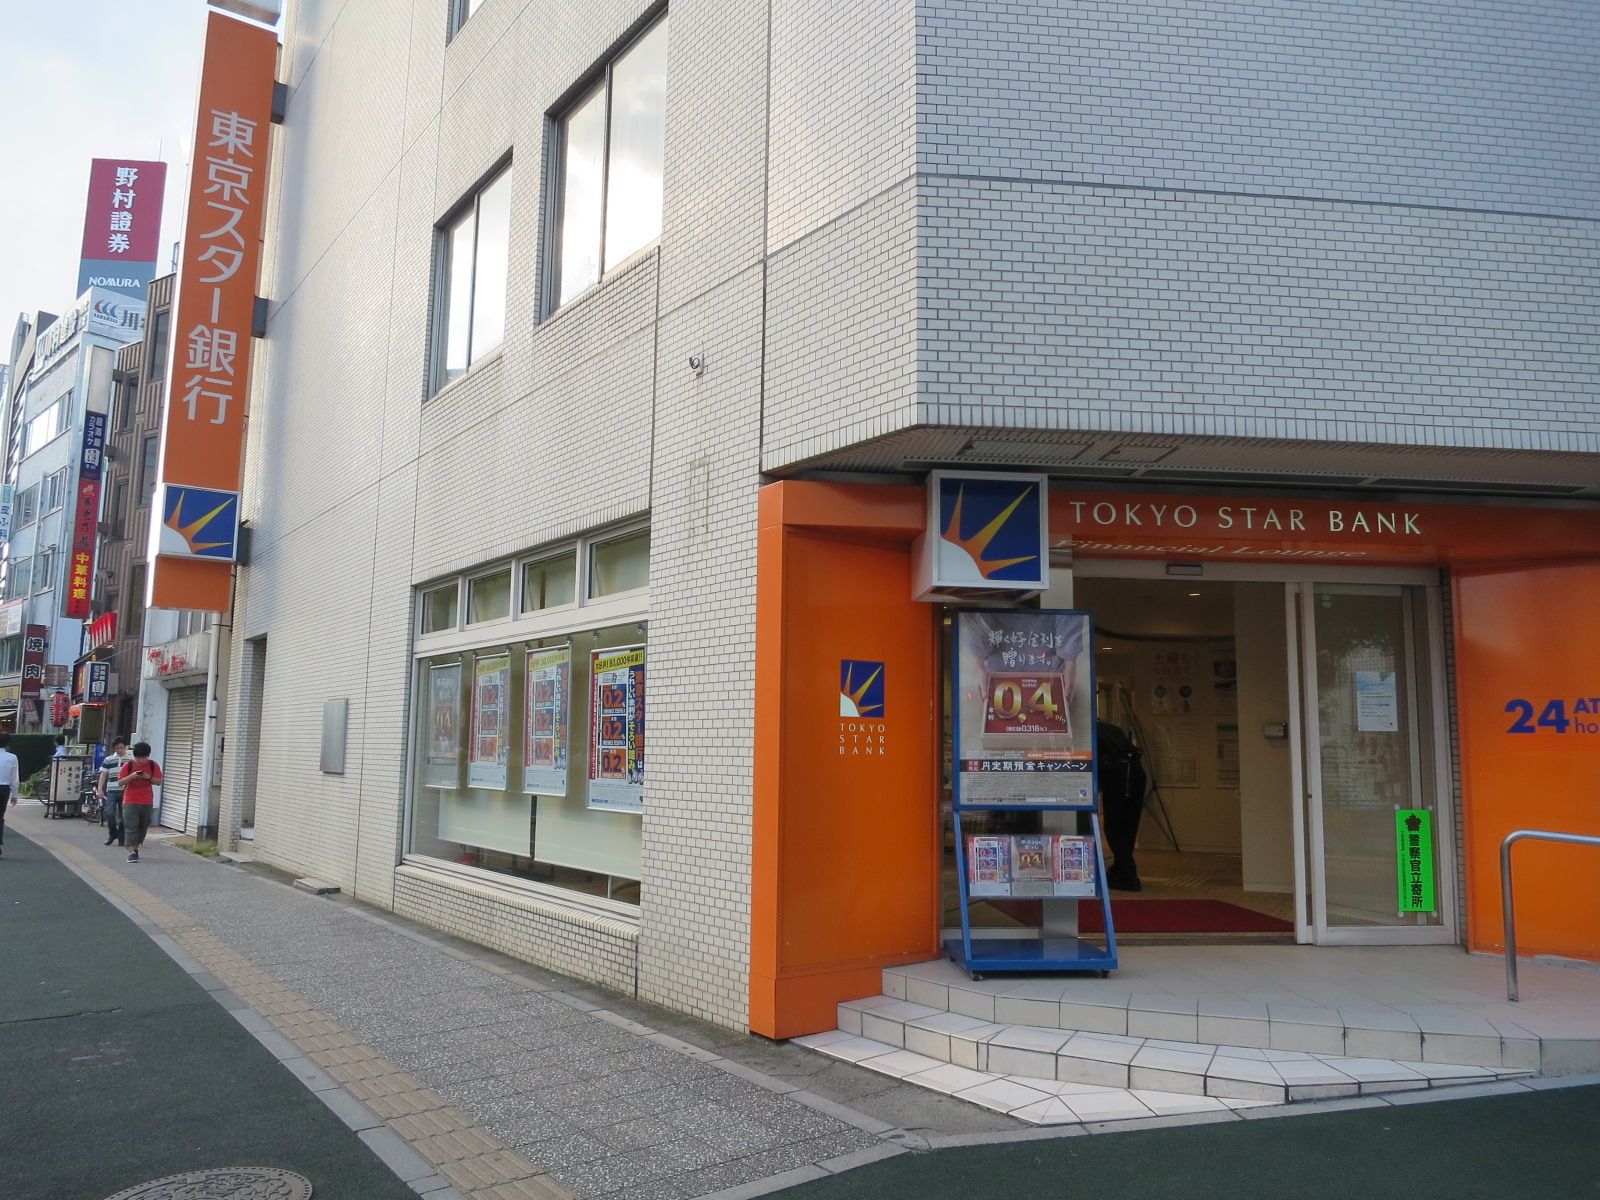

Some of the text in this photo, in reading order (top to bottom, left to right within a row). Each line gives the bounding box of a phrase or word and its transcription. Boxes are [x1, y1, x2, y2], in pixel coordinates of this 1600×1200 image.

[108, 166, 140, 254] 野村證券
[183, 108, 257, 426] 東京スター銀行
[88, 276, 141, 288] NOMURA
[121, 309, 143, 330] 川
[1069, 501, 1422, 535] TOKYO STAR BANK
[1051, 539, 1368, 558] Financial Lounge
[73, 551, 90, 600] 中華料理
[25, 636, 44, 679] 焼肉
[1002, 648, 1051, 668] 贈ります。
[1504, 698, 1600, 734] 24 AT
[839, 723, 885, 732] TOKYO
[839, 734, 885, 743] STAR
[839, 746, 885, 755] BANK
[981, 760, 1088, 771] 円定期預金キャンペーン
[1409, 834, 1424, 909] 警察官立寄所
